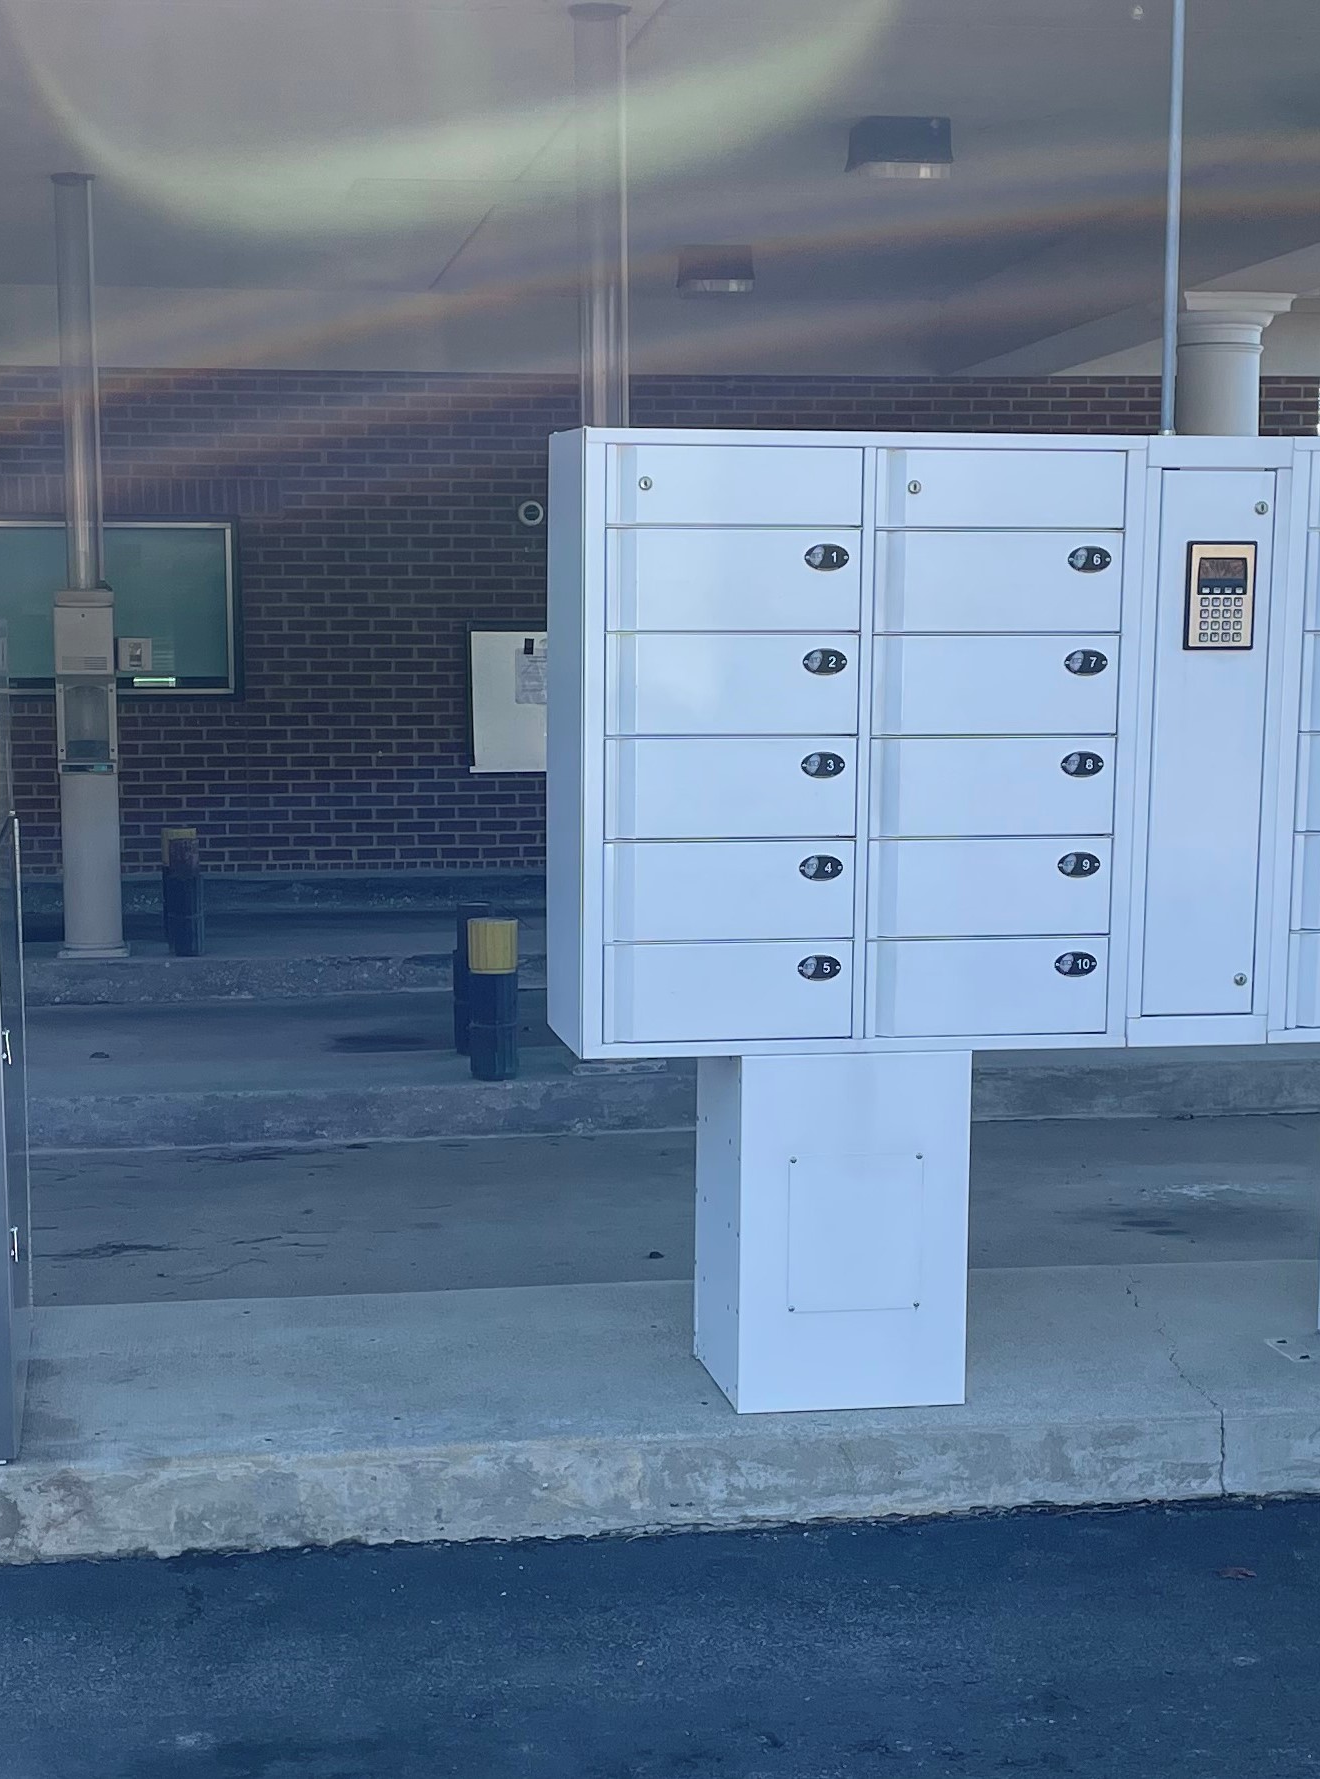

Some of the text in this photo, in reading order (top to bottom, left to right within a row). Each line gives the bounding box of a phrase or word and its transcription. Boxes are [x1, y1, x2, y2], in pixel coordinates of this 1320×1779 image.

[831, 551, 837, 563] 1
[1092, 553, 1101, 565] 6
[828, 656, 836, 668] 2
[1089, 656, 1097, 668] 7
[826, 759, 835, 770] 3
[1085, 758, 1093, 770] 8
[824, 862, 832, 872] 4
[1082, 859, 1090, 871] 9
[822, 962, 831, 973] 5
[1077, 958, 1090, 970] 10
